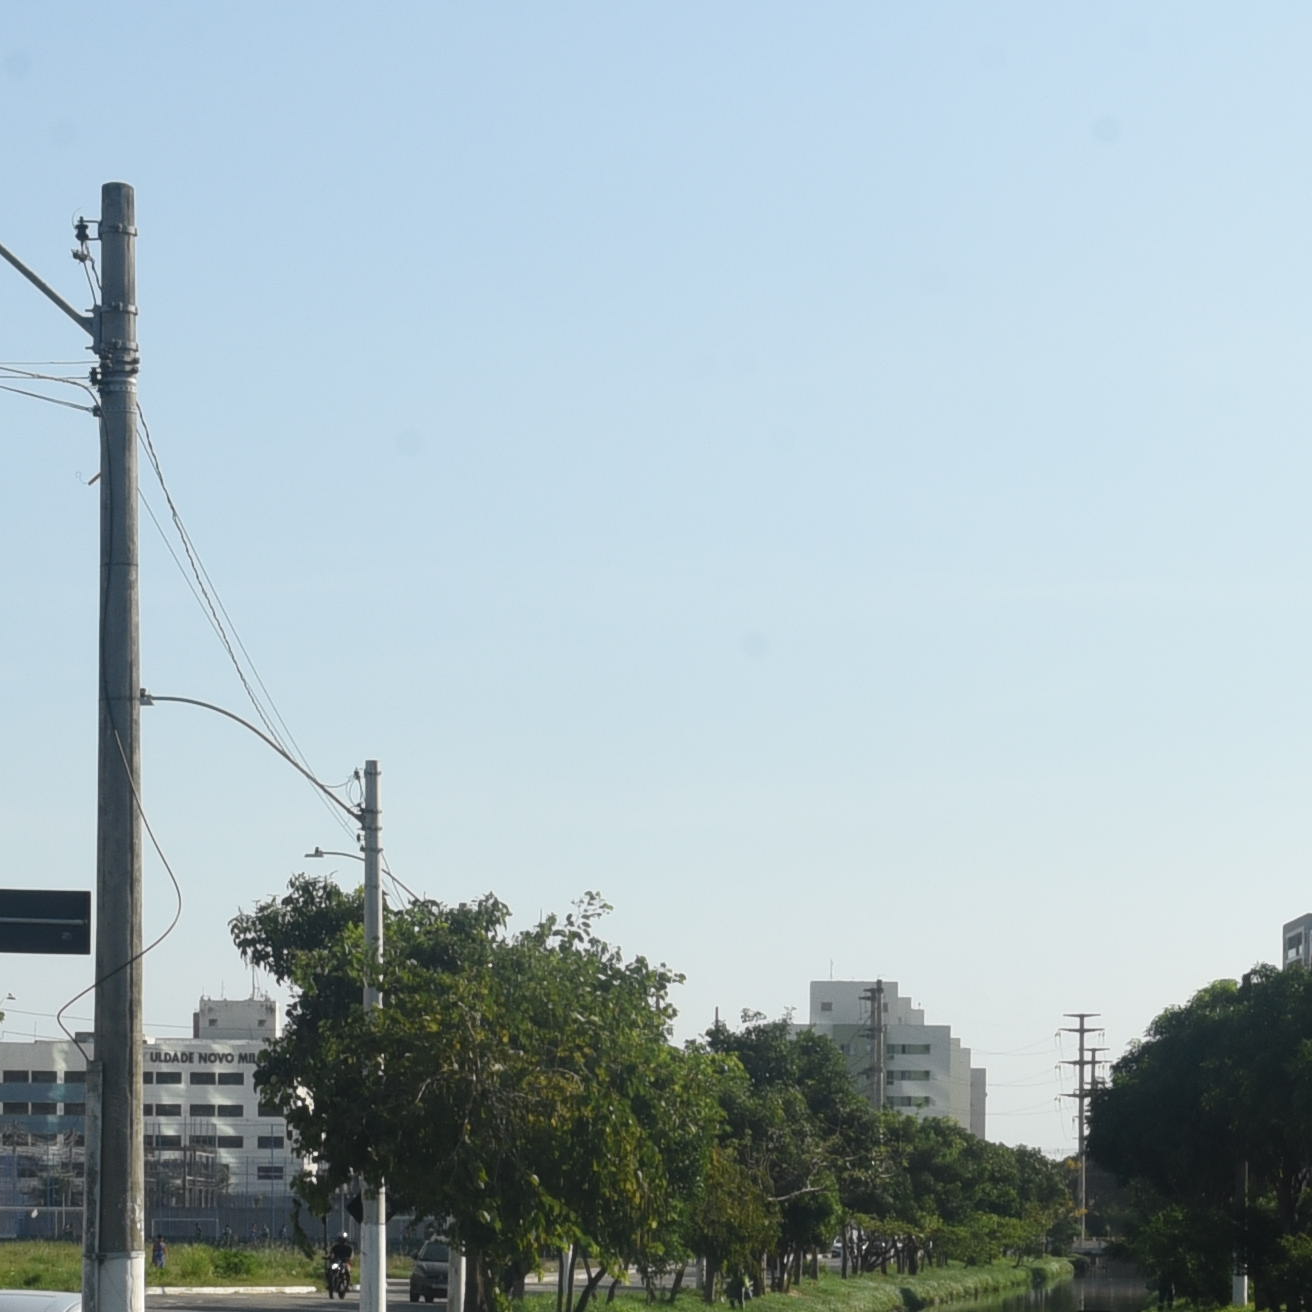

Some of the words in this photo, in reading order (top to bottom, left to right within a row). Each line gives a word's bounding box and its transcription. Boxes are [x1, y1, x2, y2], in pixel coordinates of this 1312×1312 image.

[150, 1051, 194, 1063] ULDADE
[198, 1052, 235, 1064] NOVO
[237, 1052, 257, 1064] MIL
